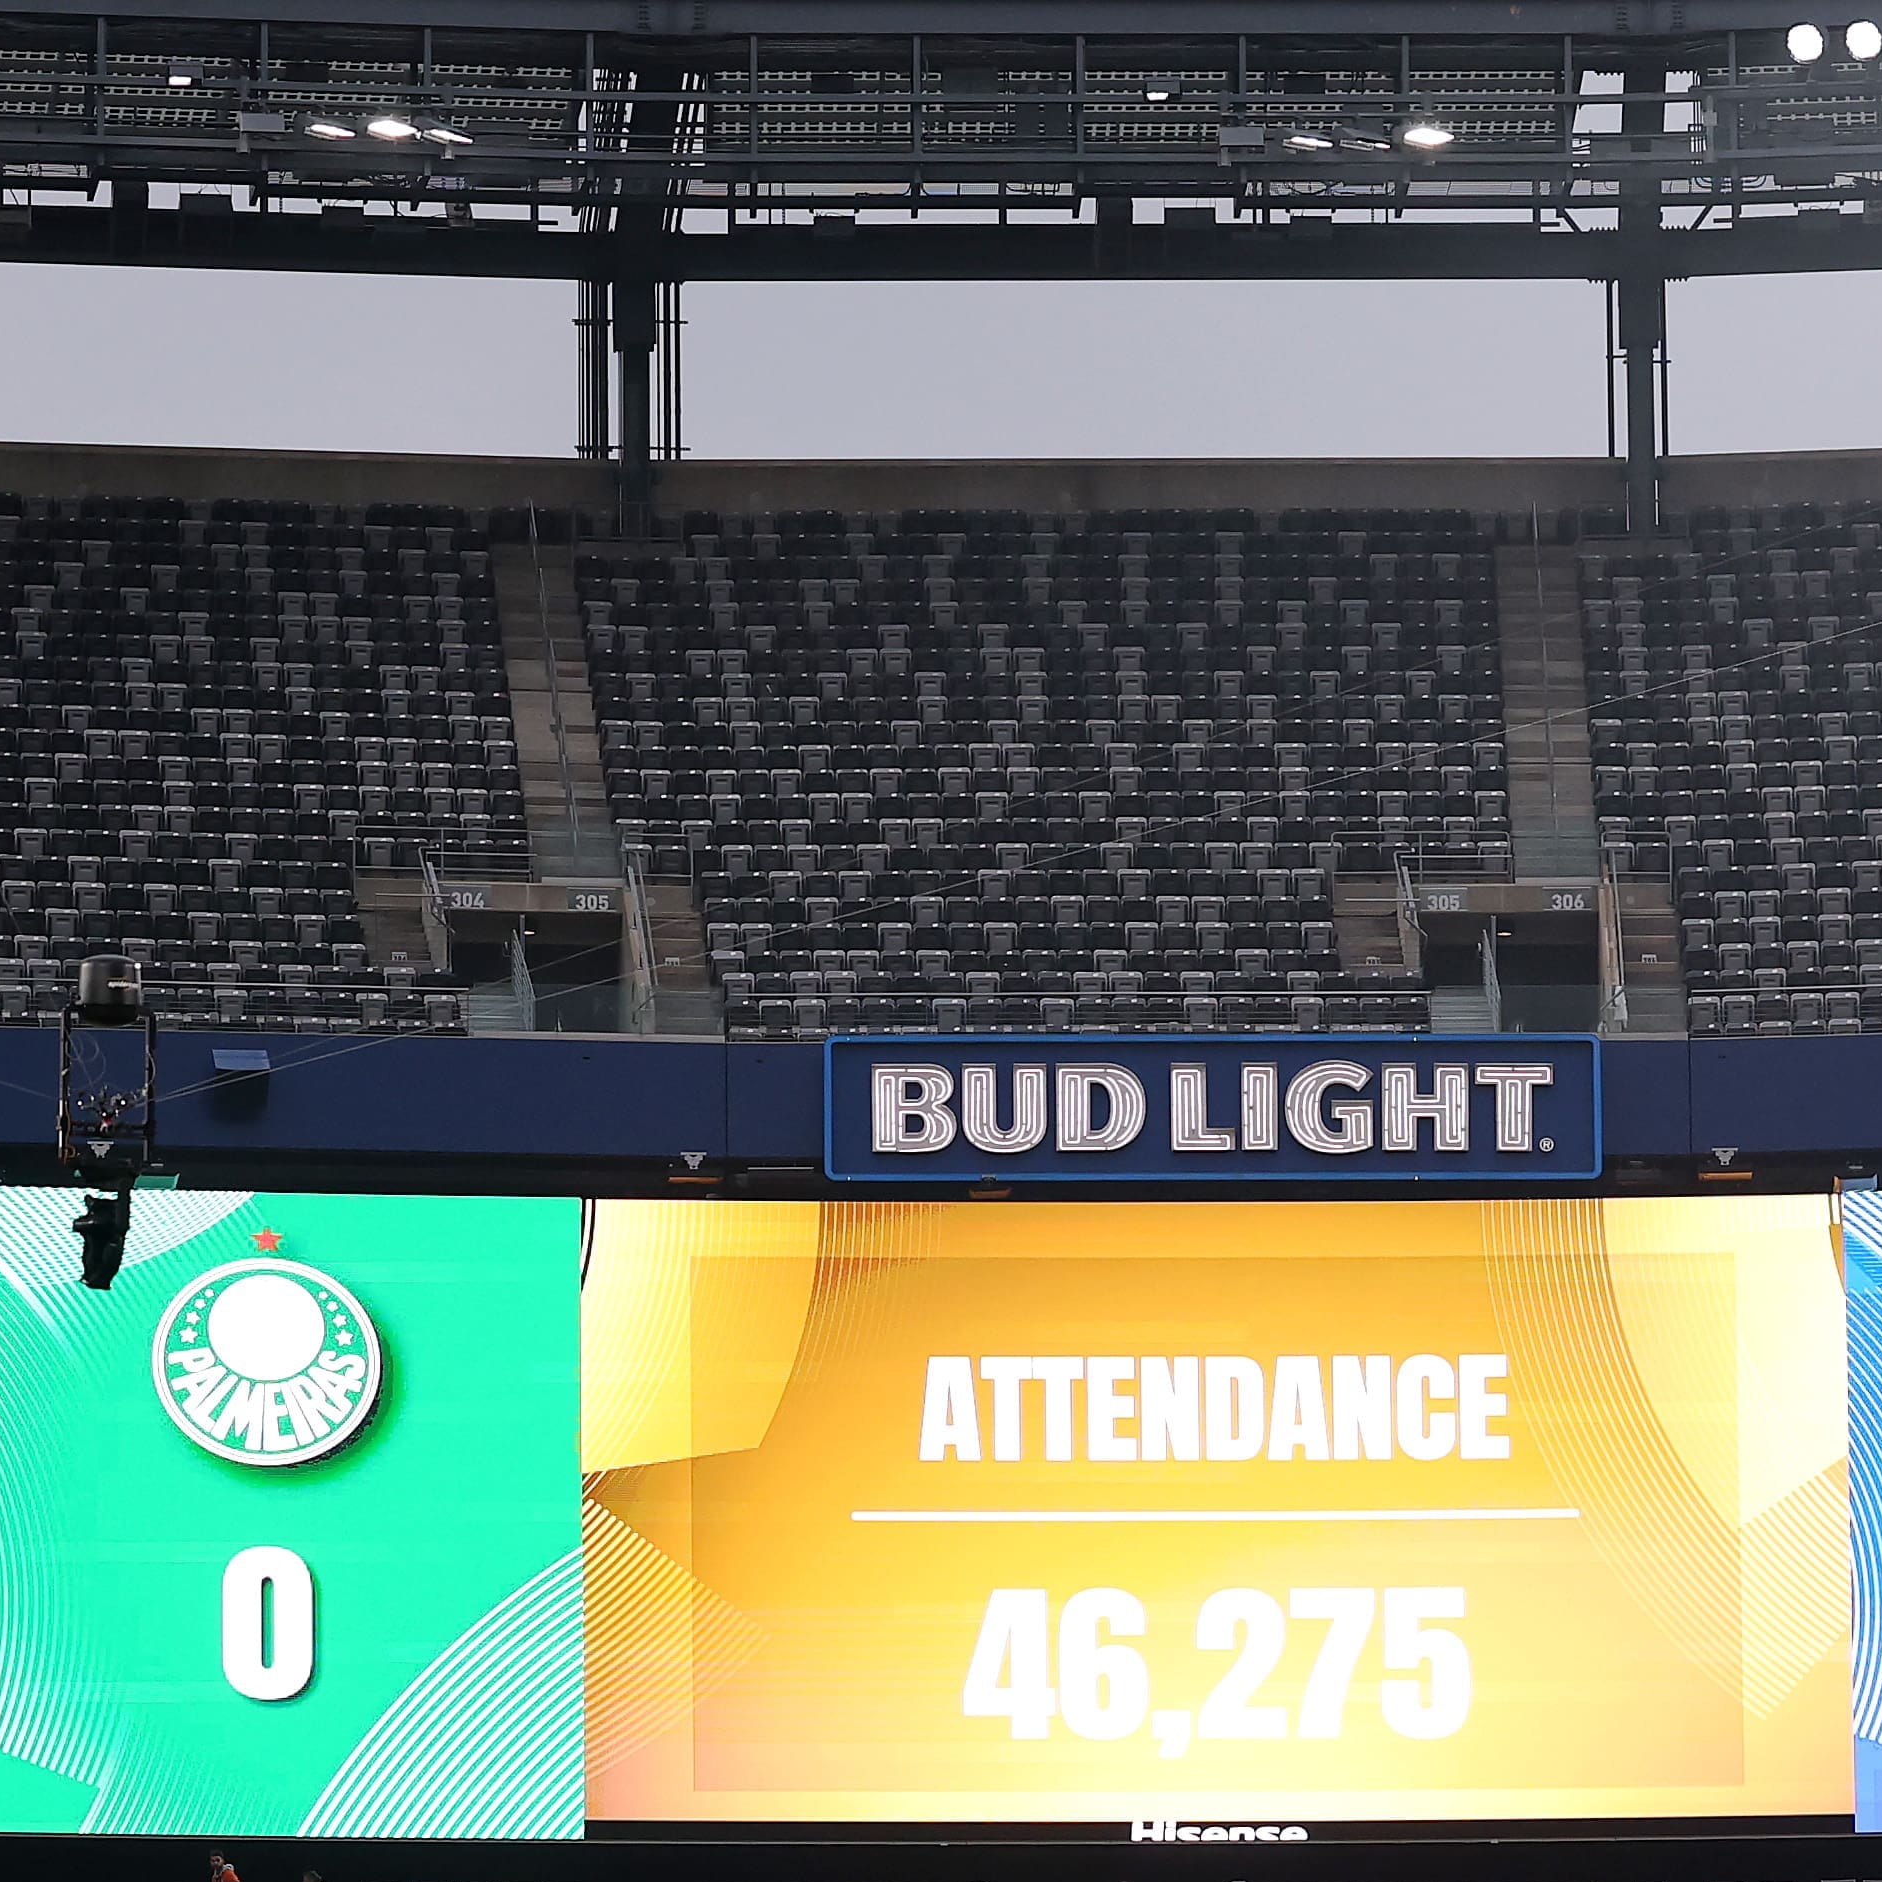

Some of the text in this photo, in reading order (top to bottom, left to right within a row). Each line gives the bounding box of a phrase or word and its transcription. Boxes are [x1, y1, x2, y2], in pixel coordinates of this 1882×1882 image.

[450, 891, 485, 909] 304
[574, 894, 609, 911] 305
[1427, 894, 1460, 911] 305
[1551, 893, 1584, 910] 306
[871, 1059, 1555, 1154] BUD LIGHT
[167, 1346, 367, 1450] PALMEIRAS
[919, 1353, 1512, 1461] ATTENDANCE
[221, 1544, 314, 1701] 0
[962, 1586, 1473, 1758] 46,275
